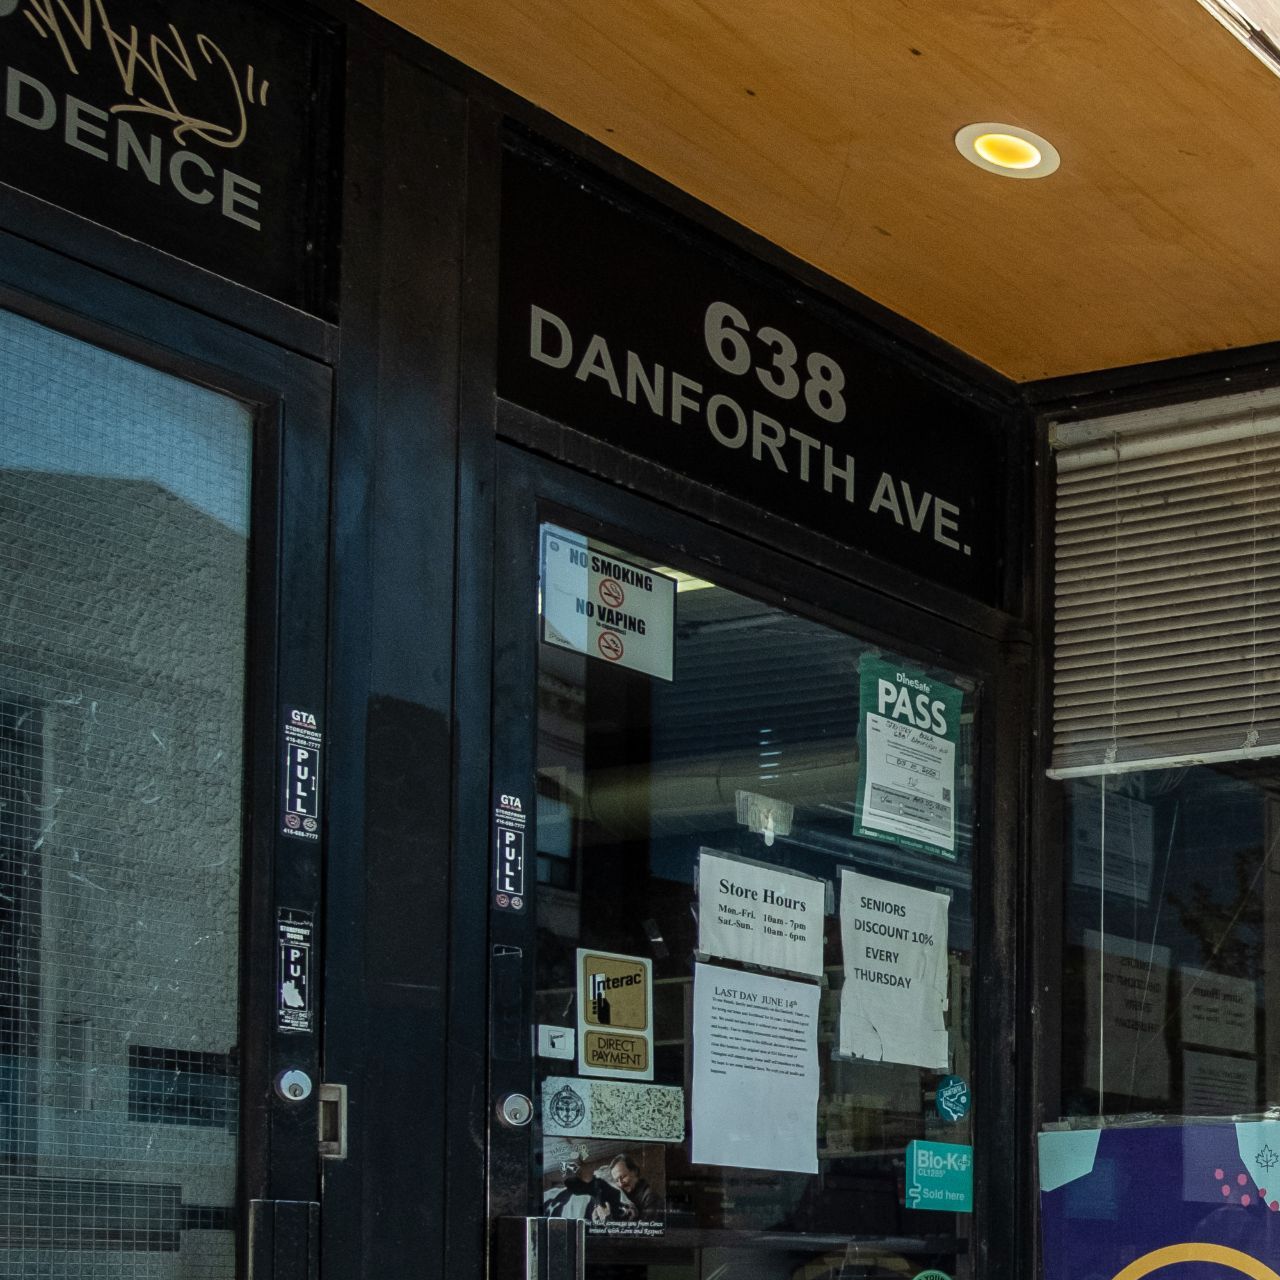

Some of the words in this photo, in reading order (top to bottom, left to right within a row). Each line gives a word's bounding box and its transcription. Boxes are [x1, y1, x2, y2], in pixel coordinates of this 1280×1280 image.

[6, 65, 263, 232] DENCE
[704, 300, 847, 423] 638
[530, 304, 855, 503] DANFORTH
[869, 472, 972, 556] AVE.
[569, 548, 588, 569] NO
[591, 556, 653, 592] SMOKING
[576, 597, 595, 618] NO
[597, 605, 646, 635] VAPING
[896, 672, 931, 694] DineSafe
[291, 710, 316, 726] GTA
[878, 678, 948, 736] PASS
[296, 748, 309, 814] PULL
[500, 794, 522, 808] GTA
[505, 831, 516, 891] PULL
[719, 878, 758, 902] Store
[762, 888, 807, 914] Hours
[860, 896, 906, 918] SENIORS
[854, 918, 910, 941] DISCOUNT
[911, 931, 934, 947] 10%
[865, 946, 900, 964] EVERY
[592, 971, 642, 998] Interac
[854, 968, 912, 990] THURSDAY
[715, 986, 738, 999] LAST
[740, 991, 758, 1002] DAY
[761, 995, 784, 1007] JUNE
[592, 1050, 642, 1066] PAYMENT
[598, 1037, 636, 1052] DIRECT
[923, 1188, 943, 1199] Sold
[945, 1189, 965, 1201] here
